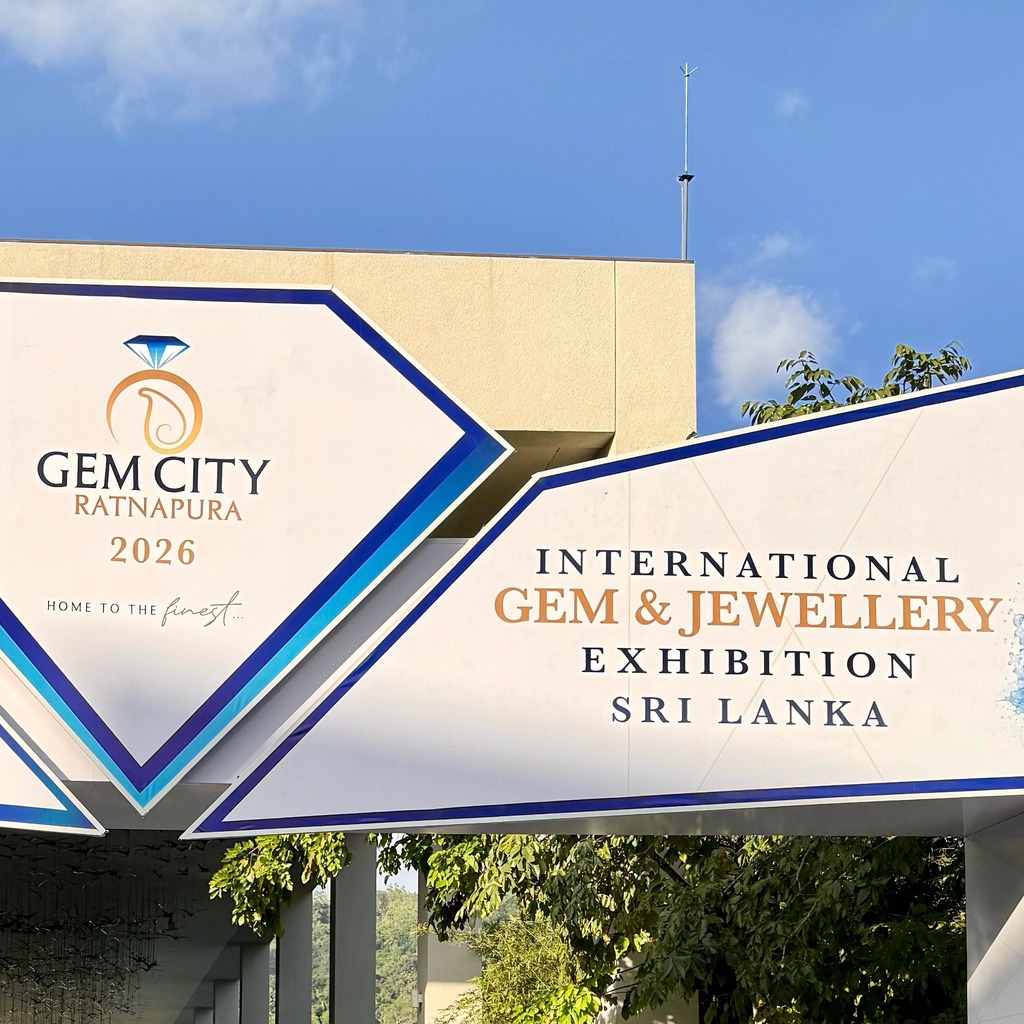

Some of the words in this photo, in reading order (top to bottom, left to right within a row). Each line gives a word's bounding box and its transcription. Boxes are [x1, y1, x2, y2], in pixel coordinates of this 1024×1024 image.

[37, 451, 142, 492] GEM
[154, 456, 271, 495] CITY
[74, 494, 242, 521] RATNAPURA
[110, 536, 195, 565] 2026
[536, 548, 960, 584] INTERNATIONAL
[47, 600, 92, 613] HOME
[99, 602, 120, 614] TO
[128, 604, 157, 616] THE
[494, 586, 619, 625] GEM
[634, 589, 672, 626] &
[678, 589, 1003, 638] JEWELLERY
[581, 646, 916, 680] EXHIBITION
[610, 695, 692, 725] SRI
[718, 697, 888, 728] LANKA
